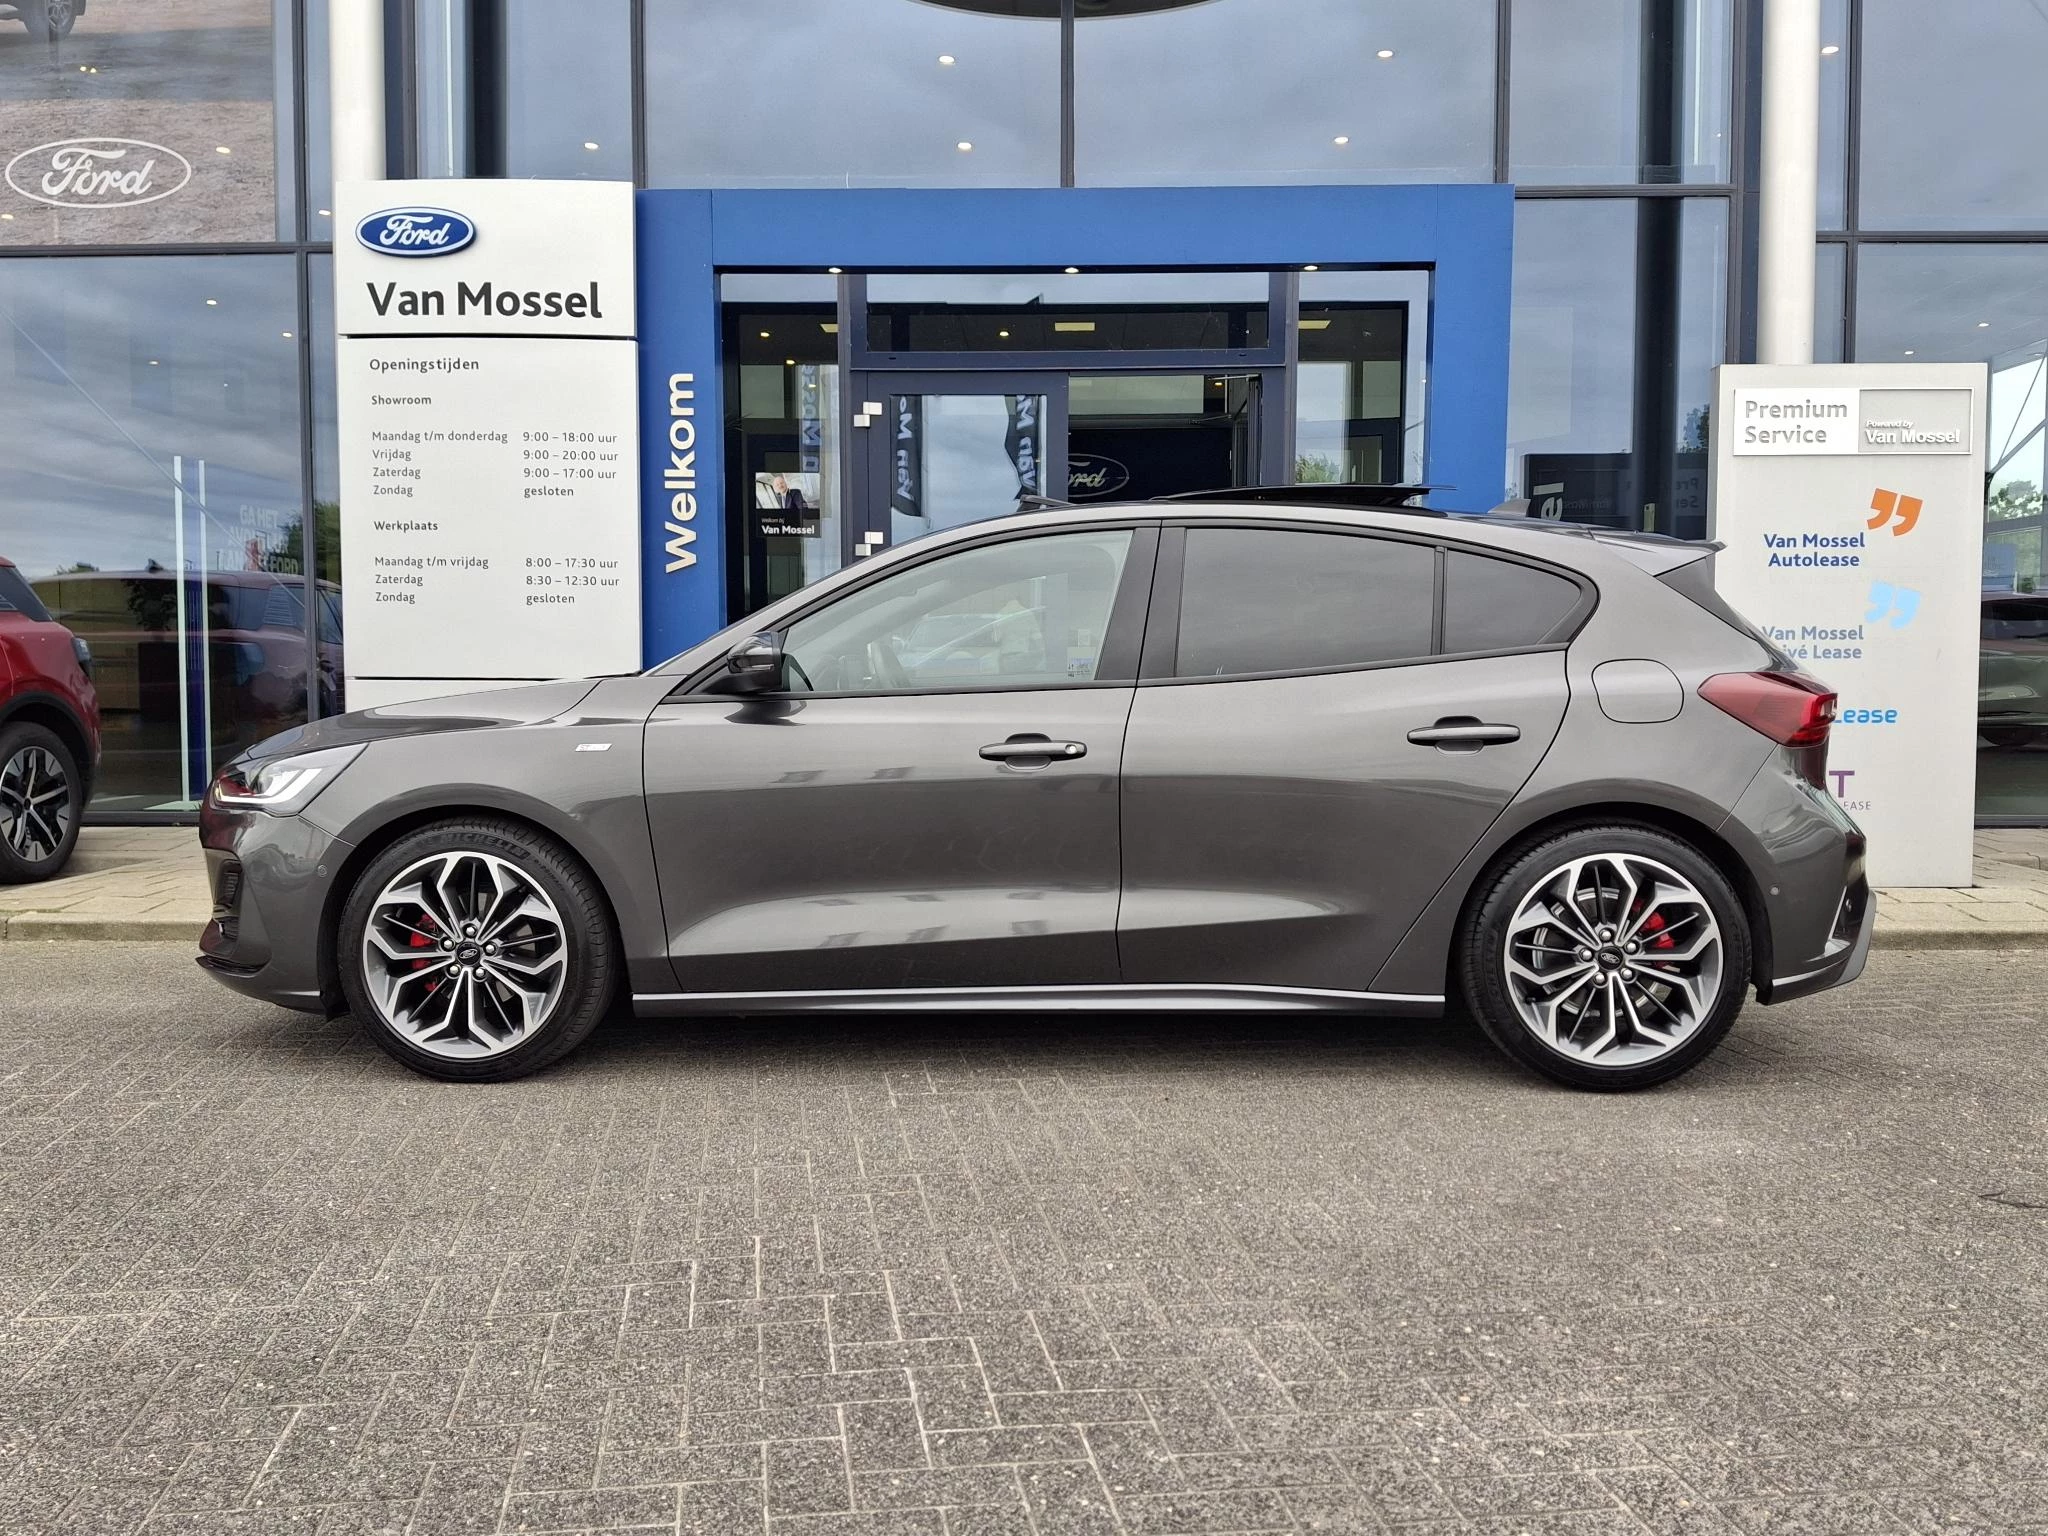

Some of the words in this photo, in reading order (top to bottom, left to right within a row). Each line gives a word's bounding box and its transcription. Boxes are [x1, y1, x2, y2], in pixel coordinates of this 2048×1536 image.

[41, 148, 155, 195] Ford
[379, 214, 451, 246] Ford
[366, 282, 444, 316] Van
[458, 281, 602, 318] Mossel
[369, 357, 480, 374] Openingstijden
[371, 395, 432, 405] Showroom
[1745, 399, 1848, 418] Premium
[1902, 420, 1914, 430] by
[372, 430, 421, 443] Maandag
[424, 431, 445, 442] t/m
[447, 430, 509, 444] donderdag
[523, 431, 549, 442] 9:00
[562, 432, 595, 443] 18:00
[598, 435, 618, 443] uur
[1745, 425, 1827, 443] Service
[1865, 429, 1897, 444] Van
[1901, 429, 1961, 444] Mossel
[372, 448, 412, 462] Vrijdag
[523, 449, 550, 460] 9:00
[562, 450, 596, 461] 20:00
[599, 453, 619, 461] uur
[373, 467, 422, 479] Zaterdag
[524, 468, 550, 478] 9:00
[563, 468, 594, 479] 17:00
[597, 471, 617, 479] uur
[664, 373, 697, 573] Welkom
[373, 485, 414, 498] Zondag
[523, 485, 574, 498] gesloten
[374, 520, 439, 533] Werkplaats
[761, 525, 780, 534] Van
[781, 525, 815, 535] Mossel
[1764, 534, 1797, 548] Van
[1802, 532, 1866, 548] Mossel
[375, 556, 424, 569] Maandag
[427, 557, 447, 567] t/m
[450, 556, 489, 569] vrijdag
[525, 558, 552, 568] 8:00
[565, 558, 596, 568] 17:30
[599, 561, 619, 569] uur
[1768, 552, 1860, 567] Autolease
[375, 574, 424, 587] Zaterdag
[526, 576, 552, 586] 8:30
[565, 576, 597, 586] 12:30
[600, 578, 620, 587] uur
[375, 592, 416, 605] Zondag
[526, 593, 575, 606] gesloten
[1762, 626, 1796, 640] Van
[1801, 625, 1864, 640] Mossel
[1813, 645, 1862, 659] Lease
